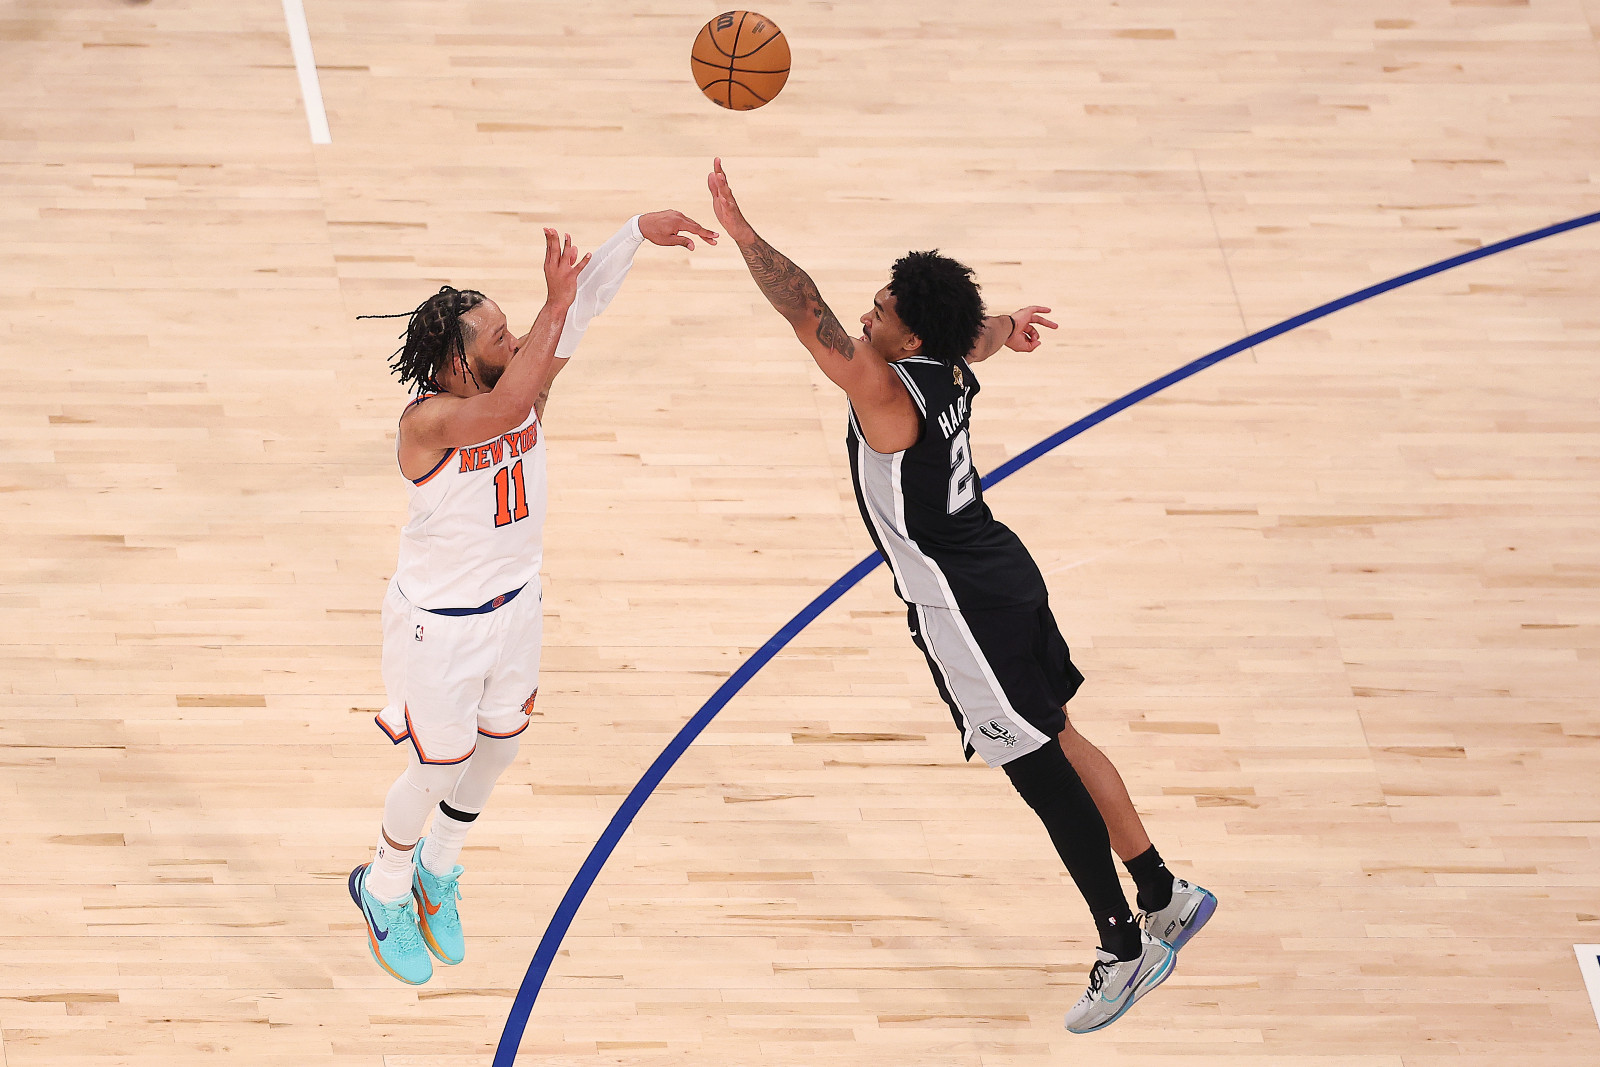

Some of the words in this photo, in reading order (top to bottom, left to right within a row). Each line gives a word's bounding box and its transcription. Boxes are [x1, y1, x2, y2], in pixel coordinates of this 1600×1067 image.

[458, 435, 504, 473] NEW
[946, 427, 976, 515] 2
[493, 459, 529, 528] 11
